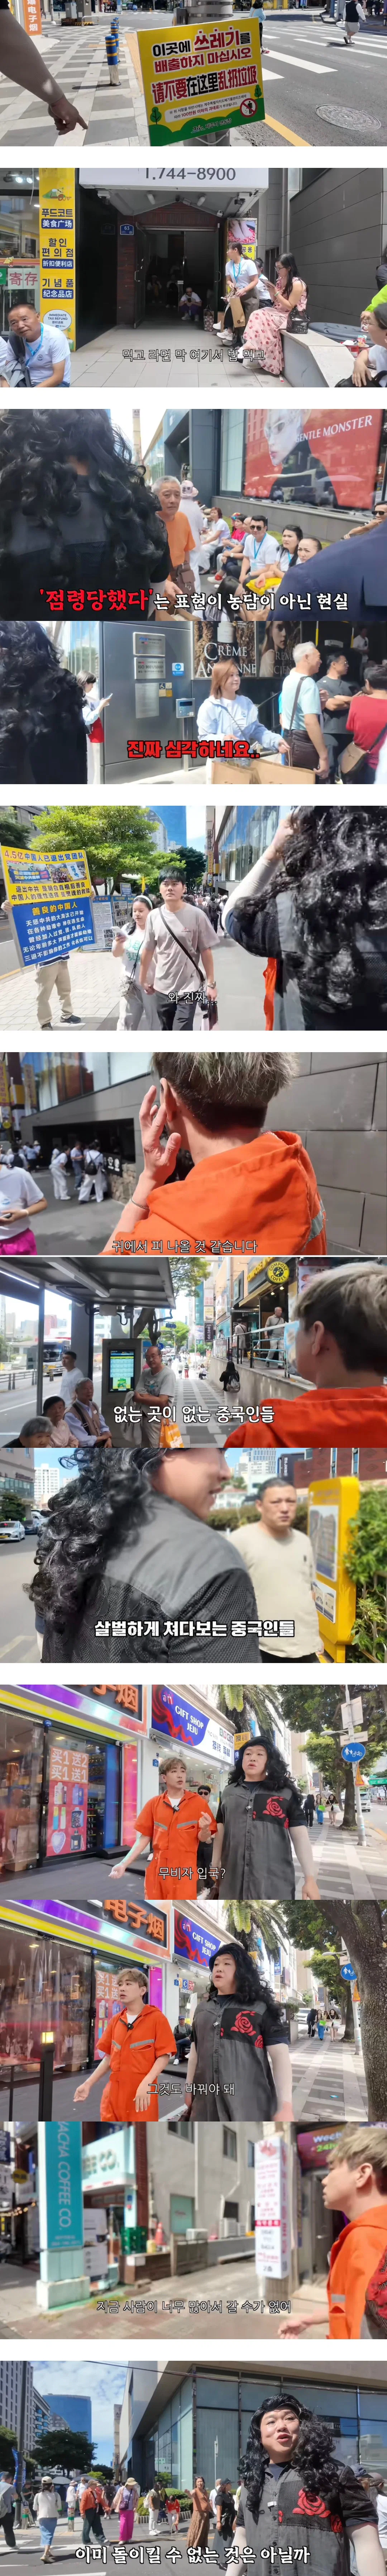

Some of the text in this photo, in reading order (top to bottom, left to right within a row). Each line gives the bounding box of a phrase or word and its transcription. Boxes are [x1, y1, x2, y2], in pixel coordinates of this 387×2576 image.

[153, 28, 250, 56] 이곳에 쓰레기를
[155, 48, 251, 72] 배출하지 마십시오
[152, 66, 257, 104] 请不要在这里乱扔垃圾
[42, 208, 73, 217] 푸드코트
[43, 220, 72, 228] 美食广场
[9, 272, 38, 286] 寄存
[296, 415, 372, 443] GENTLE MONSTER
[204, 642, 247, 660] CRÈME
[42, 882, 86, 891] 是明白真相后善良
[11, 892, 59, 901] 中国人的理性选择
[32, 901, 78, 916] 善良的中国人
[23, 939, 57, 953] 无论年龄多大
[24, 936, 93, 962] 三退不影响你的工作 化名也可以
[269, 1262, 287, 1271] COMPOSE
[175, 1705, 204, 1729] GIFT SHOP
[187, 1723, 198, 1735] JEJU
[192, 1932, 216, 1951] GIFT SHOP
[202, 1946, 211, 1956] JEJU
[58, 2161, 71, 2205] COFFEE
[58, 2208, 71, 2230] CO.
